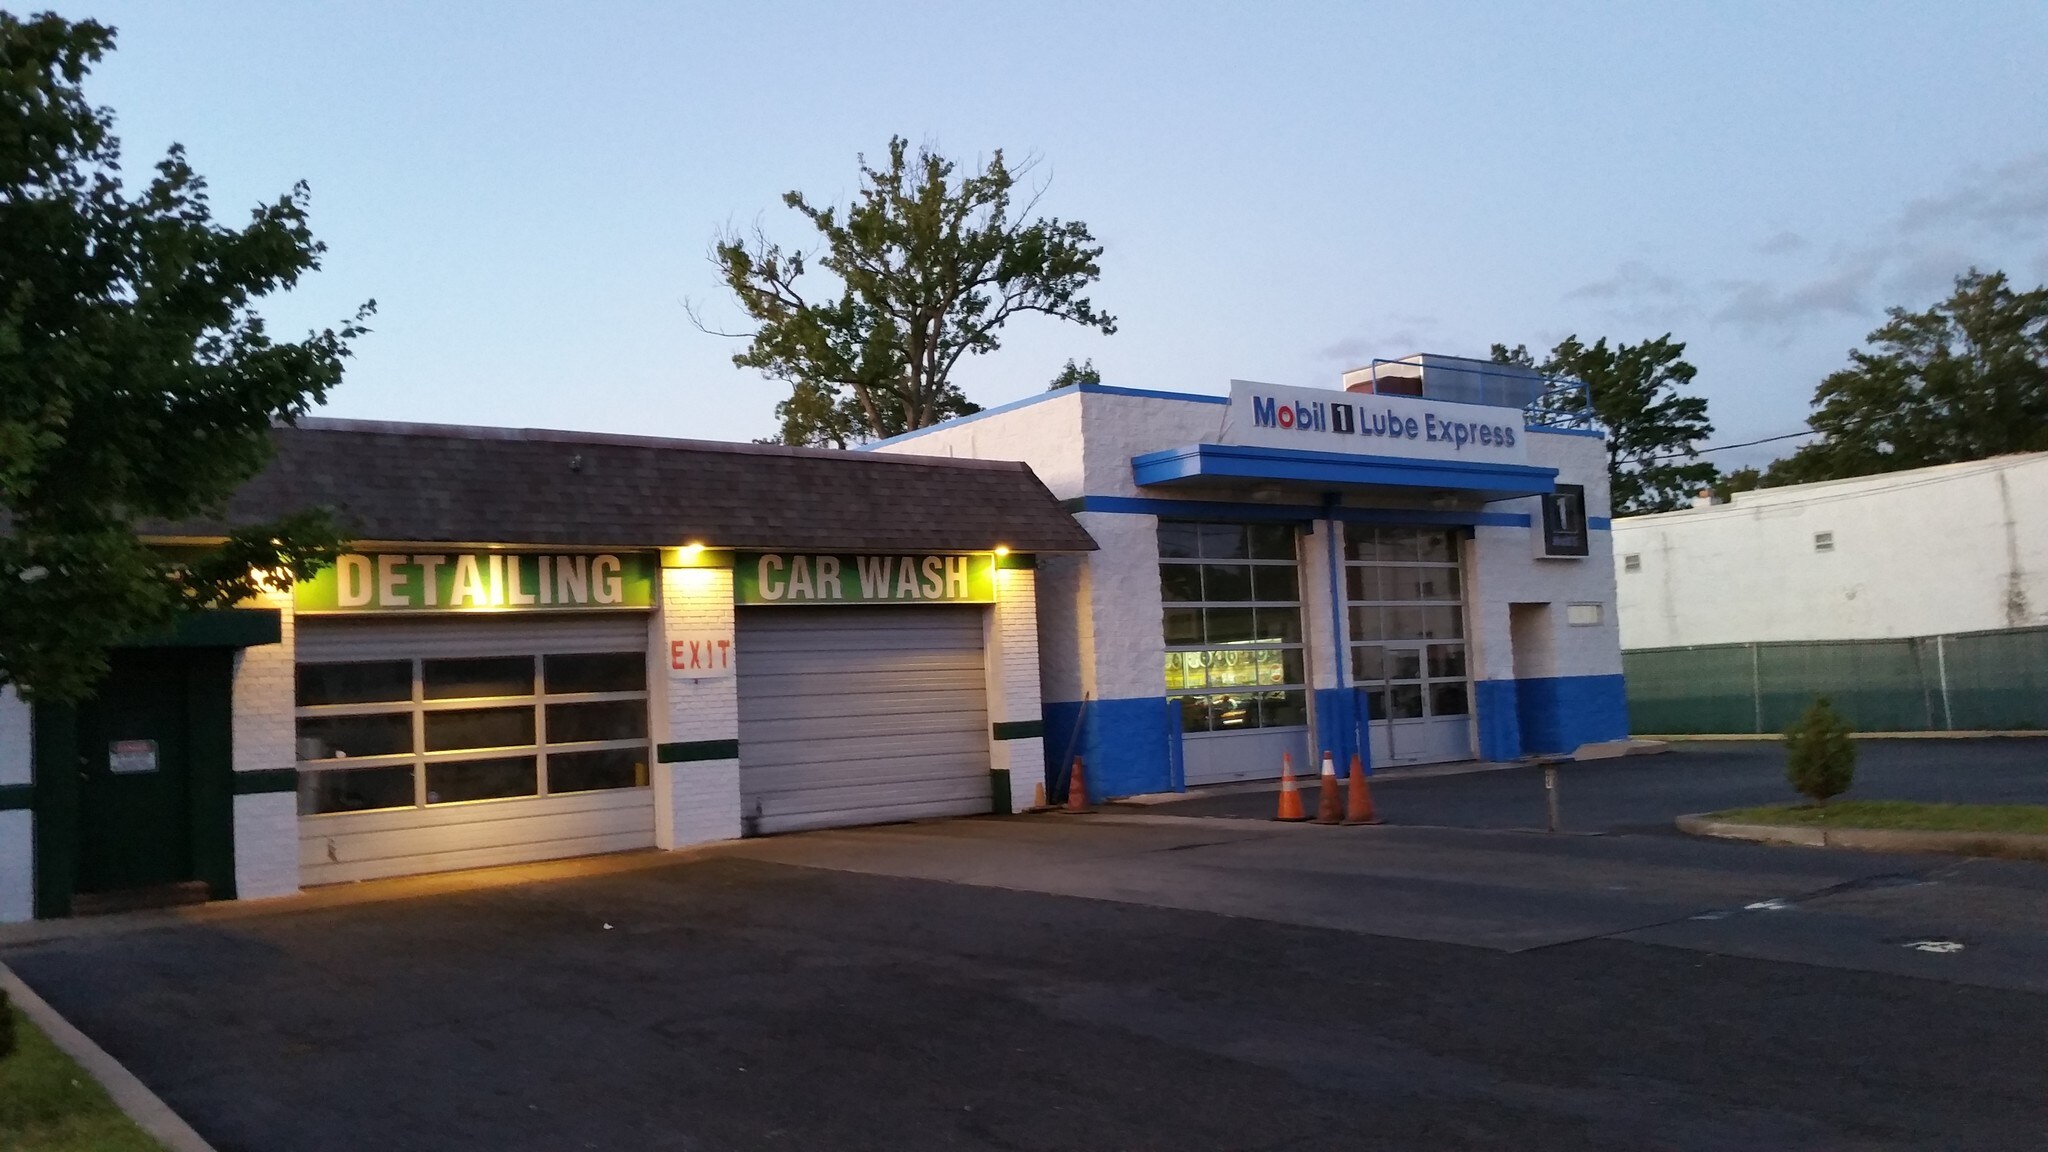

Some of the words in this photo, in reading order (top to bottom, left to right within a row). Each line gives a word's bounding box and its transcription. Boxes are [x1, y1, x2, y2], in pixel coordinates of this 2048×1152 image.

[1253, 395, 1326, 432] Mobil
[1334, 403, 1351, 433] 1
[1359, 406, 1419, 438] Lube
[1425, 413, 1516, 450] Express
[336, 553, 624, 607] DETAILING
[757, 553, 843, 601] CAR
[856, 555, 969, 600] WASH
[671, 639, 731, 670] EXIT
